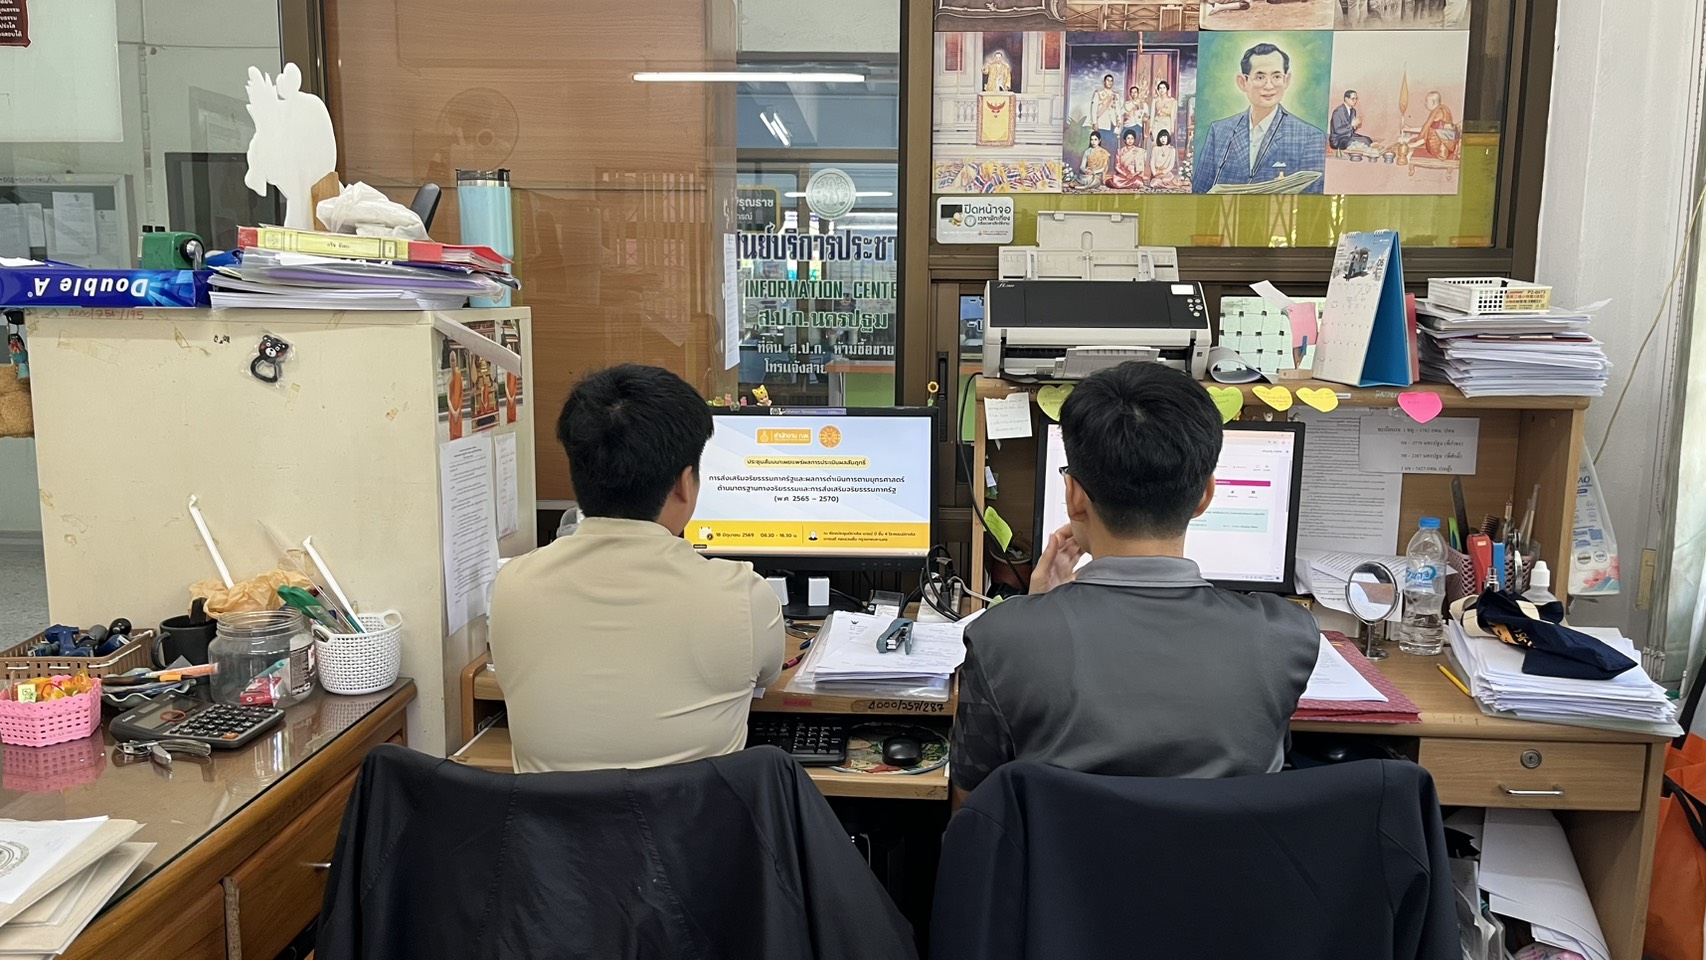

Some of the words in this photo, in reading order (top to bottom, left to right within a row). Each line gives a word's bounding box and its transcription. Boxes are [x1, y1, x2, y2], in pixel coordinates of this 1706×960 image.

[737, 197, 774, 211] รุณราช
[964, 203, 1011, 218] ปิดหน้าจอ
[60, 277, 149, 298] Double
[745, 280, 843, 299] INFORMATION
[757, 336, 783, 354] ที่ดิน
[789, 341, 827, 355] ส.ป.ก.
[819, 495, 839, 503] 2570)
